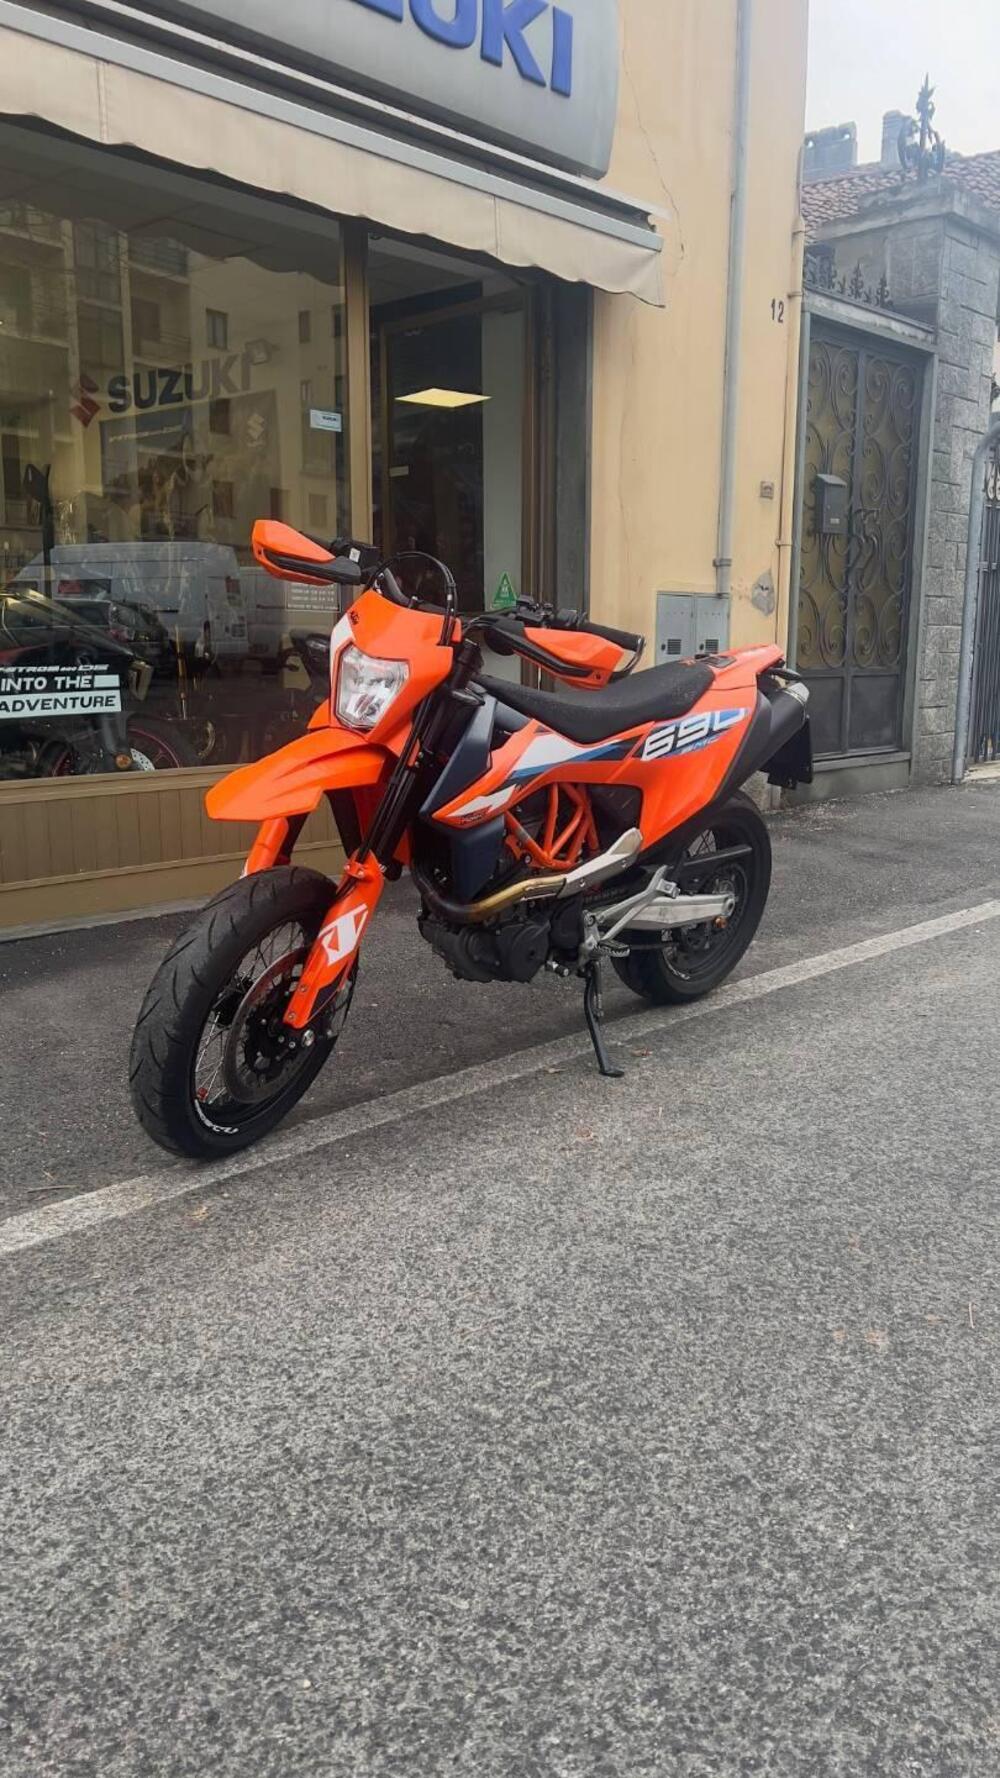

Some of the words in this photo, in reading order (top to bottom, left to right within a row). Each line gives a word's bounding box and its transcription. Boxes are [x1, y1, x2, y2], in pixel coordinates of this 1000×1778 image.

[771, 298, 785, 323] 12
[107, 353, 252, 413] SUZUKI
[1, 676, 47, 691] INTO
[54, 675, 92, 689] THE
[0, 695, 116, 712] ADVENTURE
